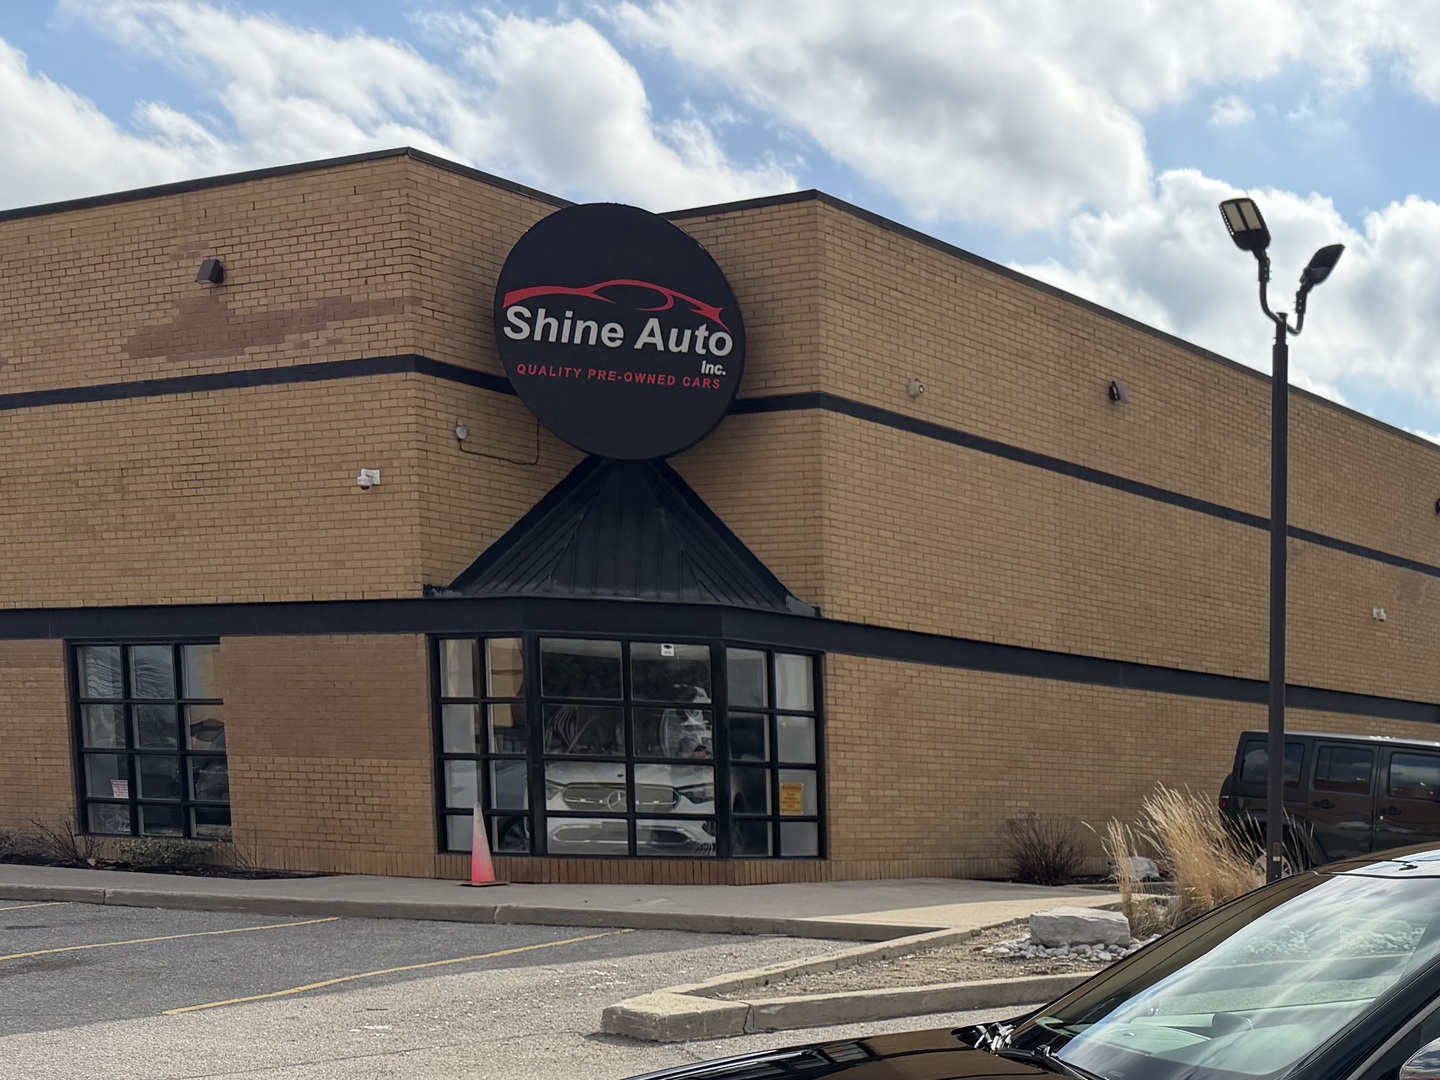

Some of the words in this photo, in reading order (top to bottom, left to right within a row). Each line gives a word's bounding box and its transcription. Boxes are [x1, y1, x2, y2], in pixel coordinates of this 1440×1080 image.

[503, 305, 624, 347] Shine
[634, 317, 733, 357] Auto
[517, 363, 582, 379] QUALITY
[588, 368, 676, 386] PRE-OWNED
[683, 376, 721, 390] CARS
[701, 360, 726, 375] Inc.
